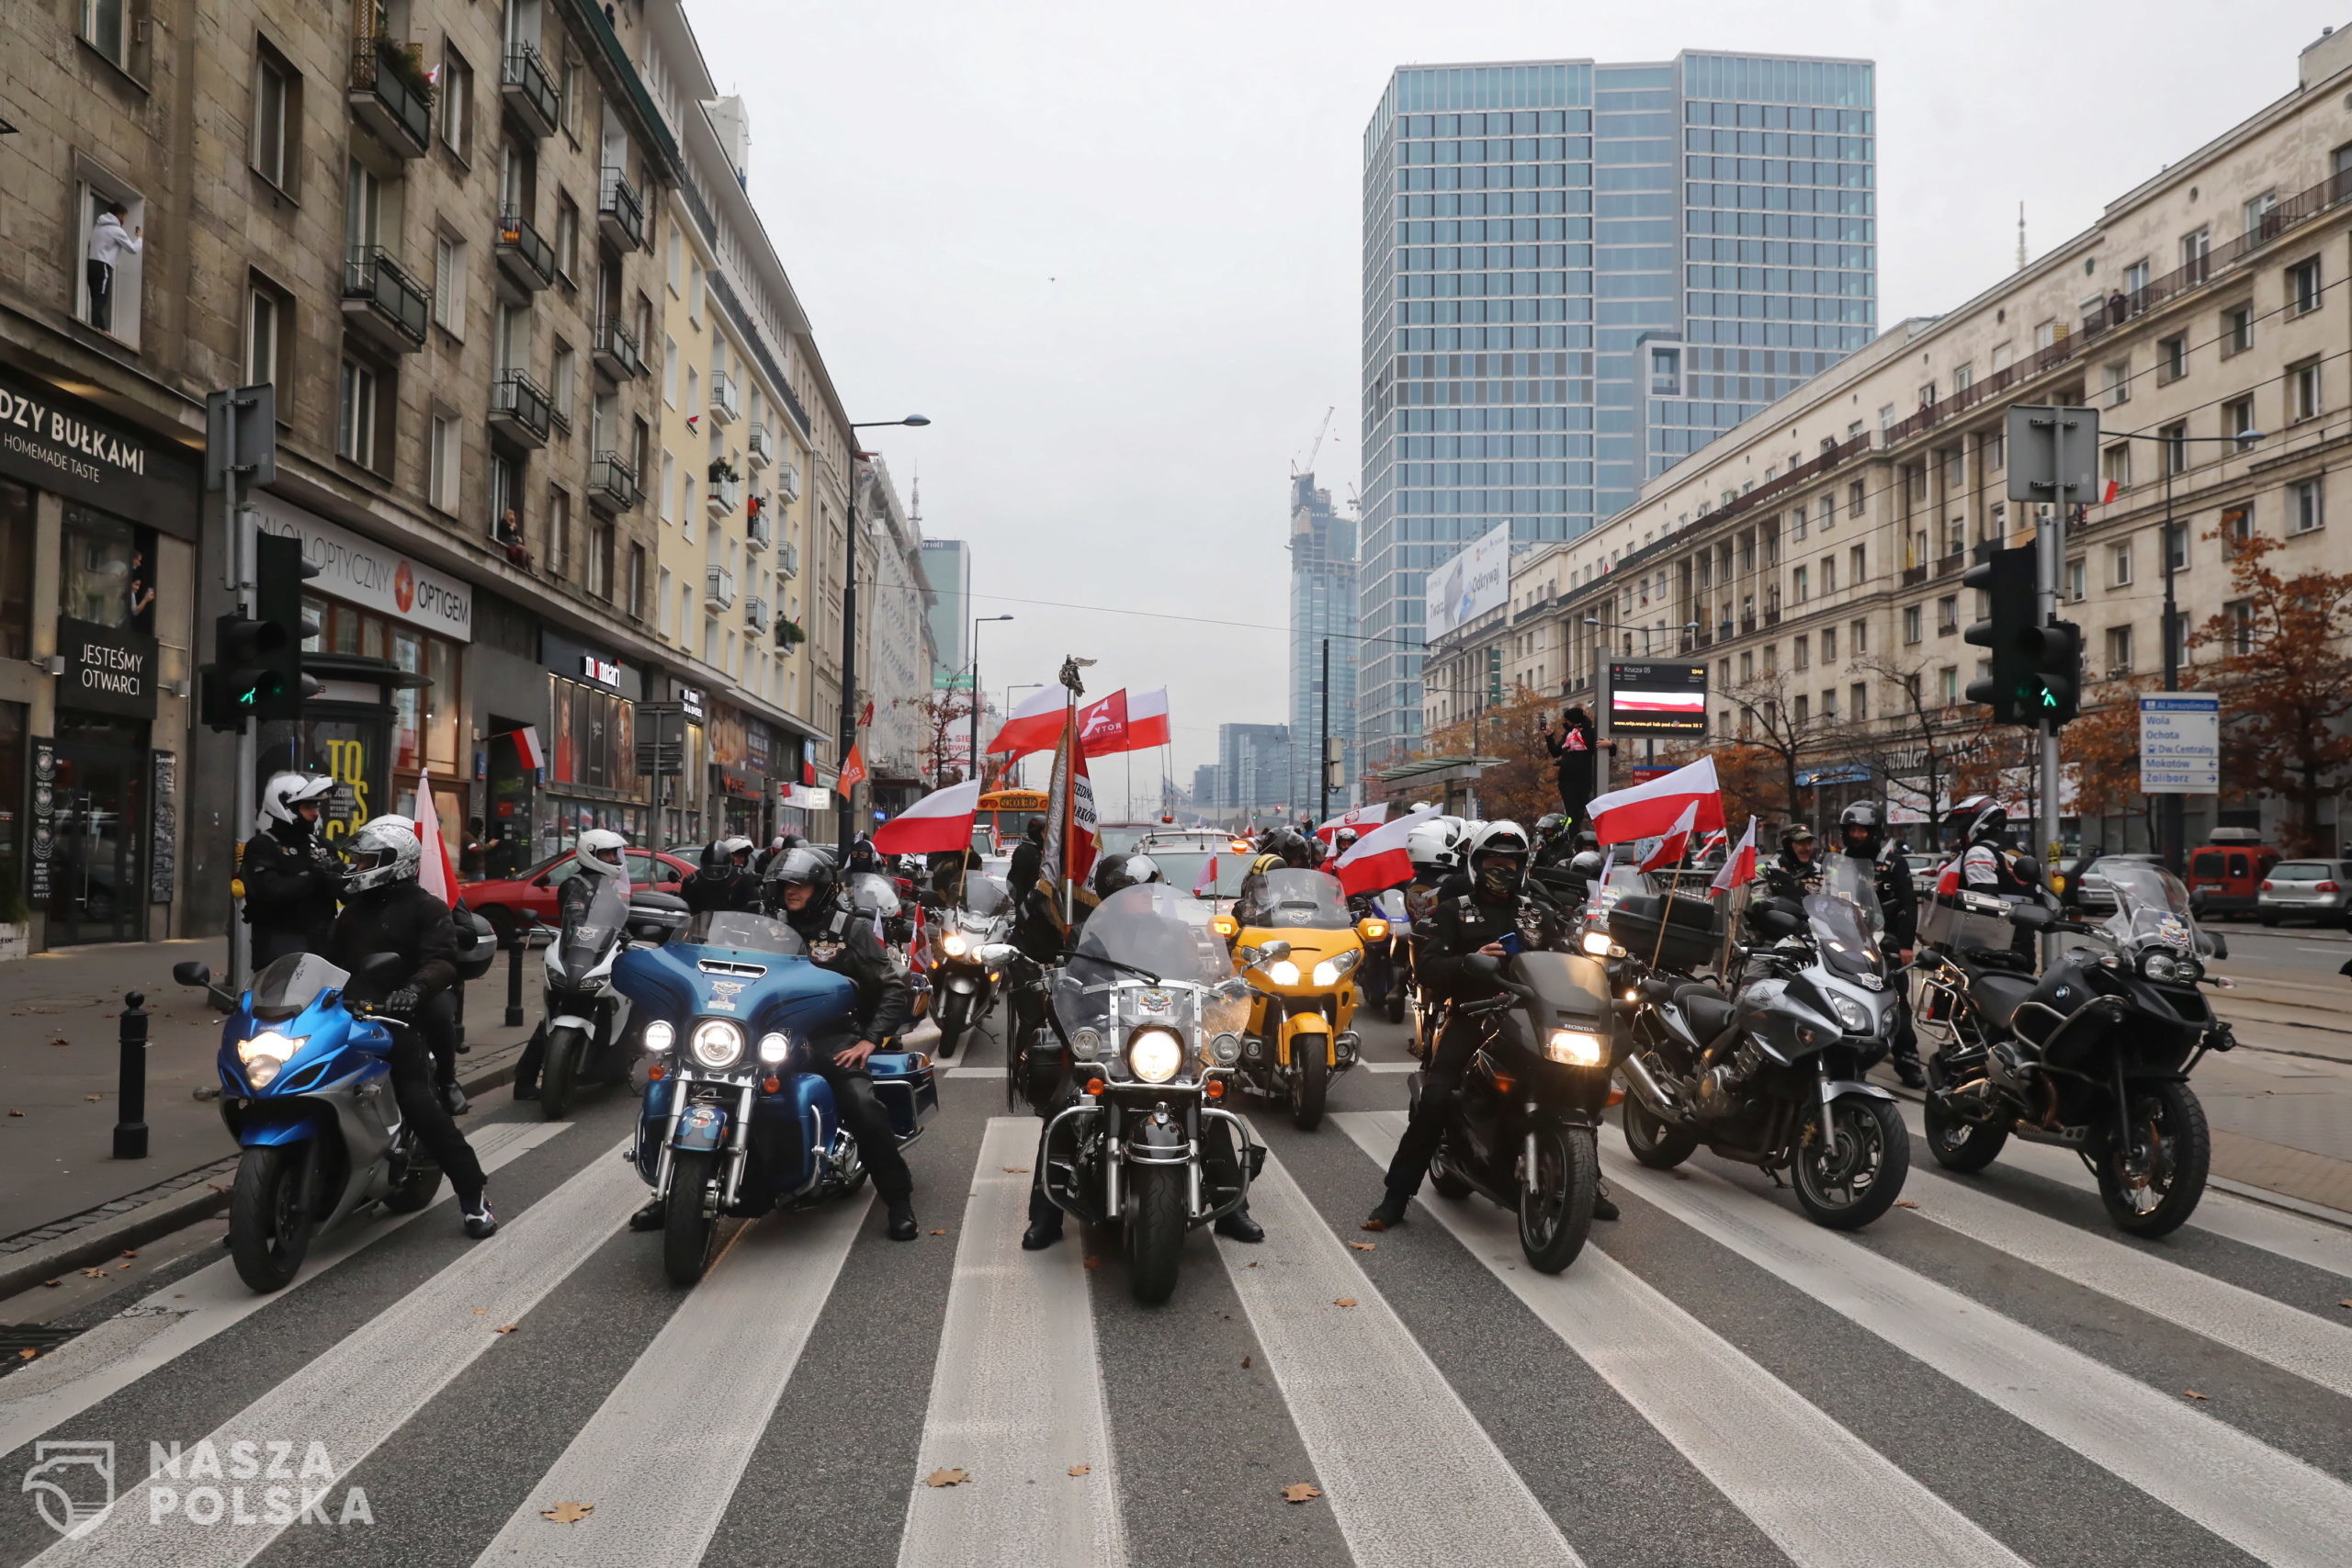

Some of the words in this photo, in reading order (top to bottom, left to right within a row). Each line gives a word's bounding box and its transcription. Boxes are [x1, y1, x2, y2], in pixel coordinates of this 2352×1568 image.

[51, 412, 144, 476] BUŁKAMI
[4, 433, 68, 470] HOMEMADE
[70, 458, 100, 483] TASTE
[417, 581, 469, 626] OPTIGEM
[80, 644, 143, 673] JESTEŚMY
[585, 656, 622, 687] monnari
[82, 669, 140, 695] OTWARCI
[2146, 716, 2170, 725] Wola
[2146, 730, 2179, 739] Ochota
[2146, 759, 2190, 768] Mokotów
[1001, 797, 1023, 808] SCHOOL
[1023, 797, 1037, 808] BUS
[1564, 1023, 1595, 1032] HONDA
